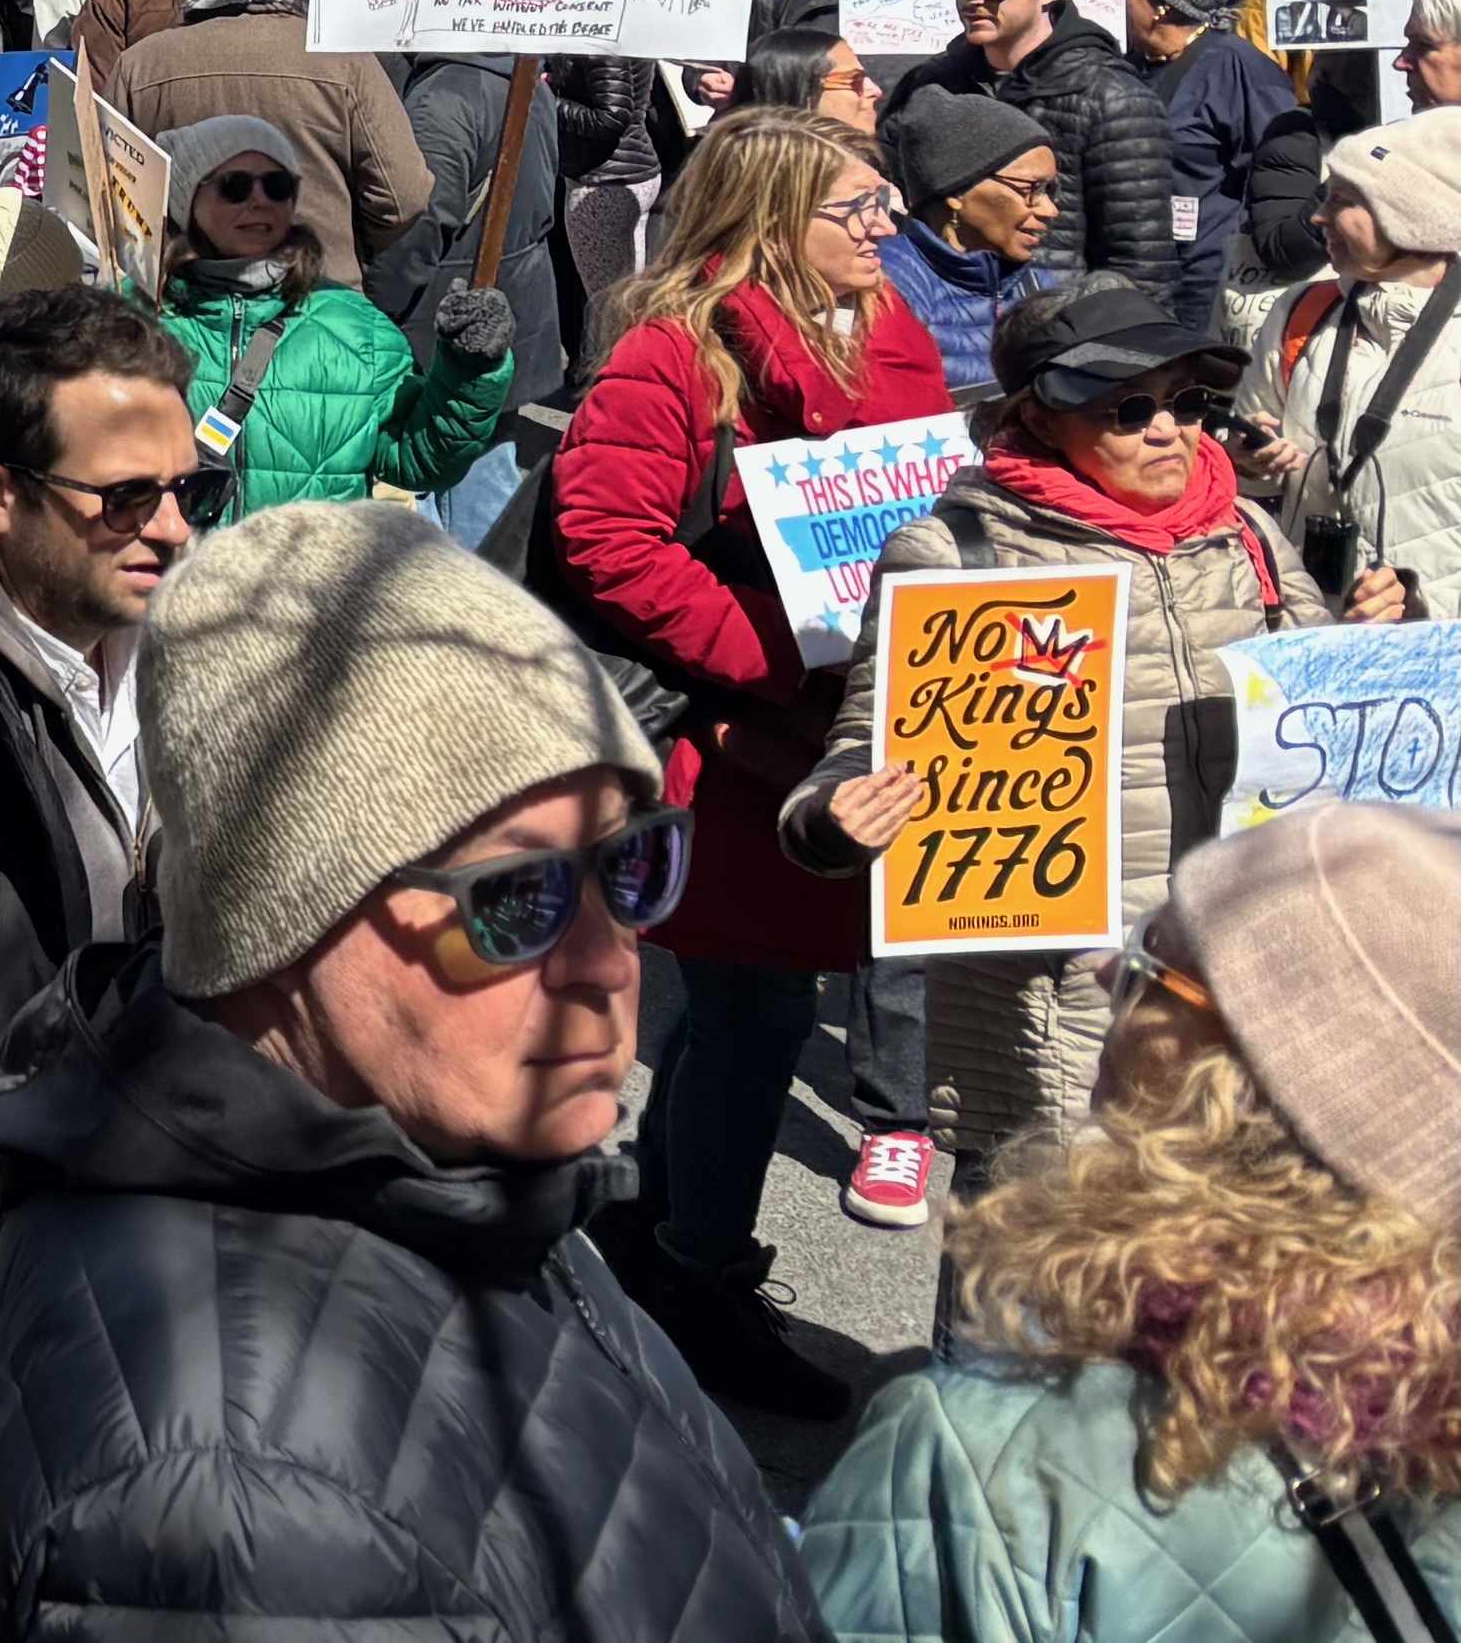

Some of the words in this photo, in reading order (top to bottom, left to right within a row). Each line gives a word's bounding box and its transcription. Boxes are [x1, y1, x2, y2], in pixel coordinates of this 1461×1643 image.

[555, 1, 614, 12] CONSENT
[796, 474, 856, 521] THIS
[860, 470, 880, 507] IS
[885, 453, 965, 499] WHAT
[908, 589, 1077, 668] No
[894, 676, 1098, 750] Kings
[905, 745, 1095, 823] Since
[1258, 696, 1461, 811] STO
[901, 817, 1088, 906] 1776
[948, 913, 1041, 931] NOKINGS.ORG
